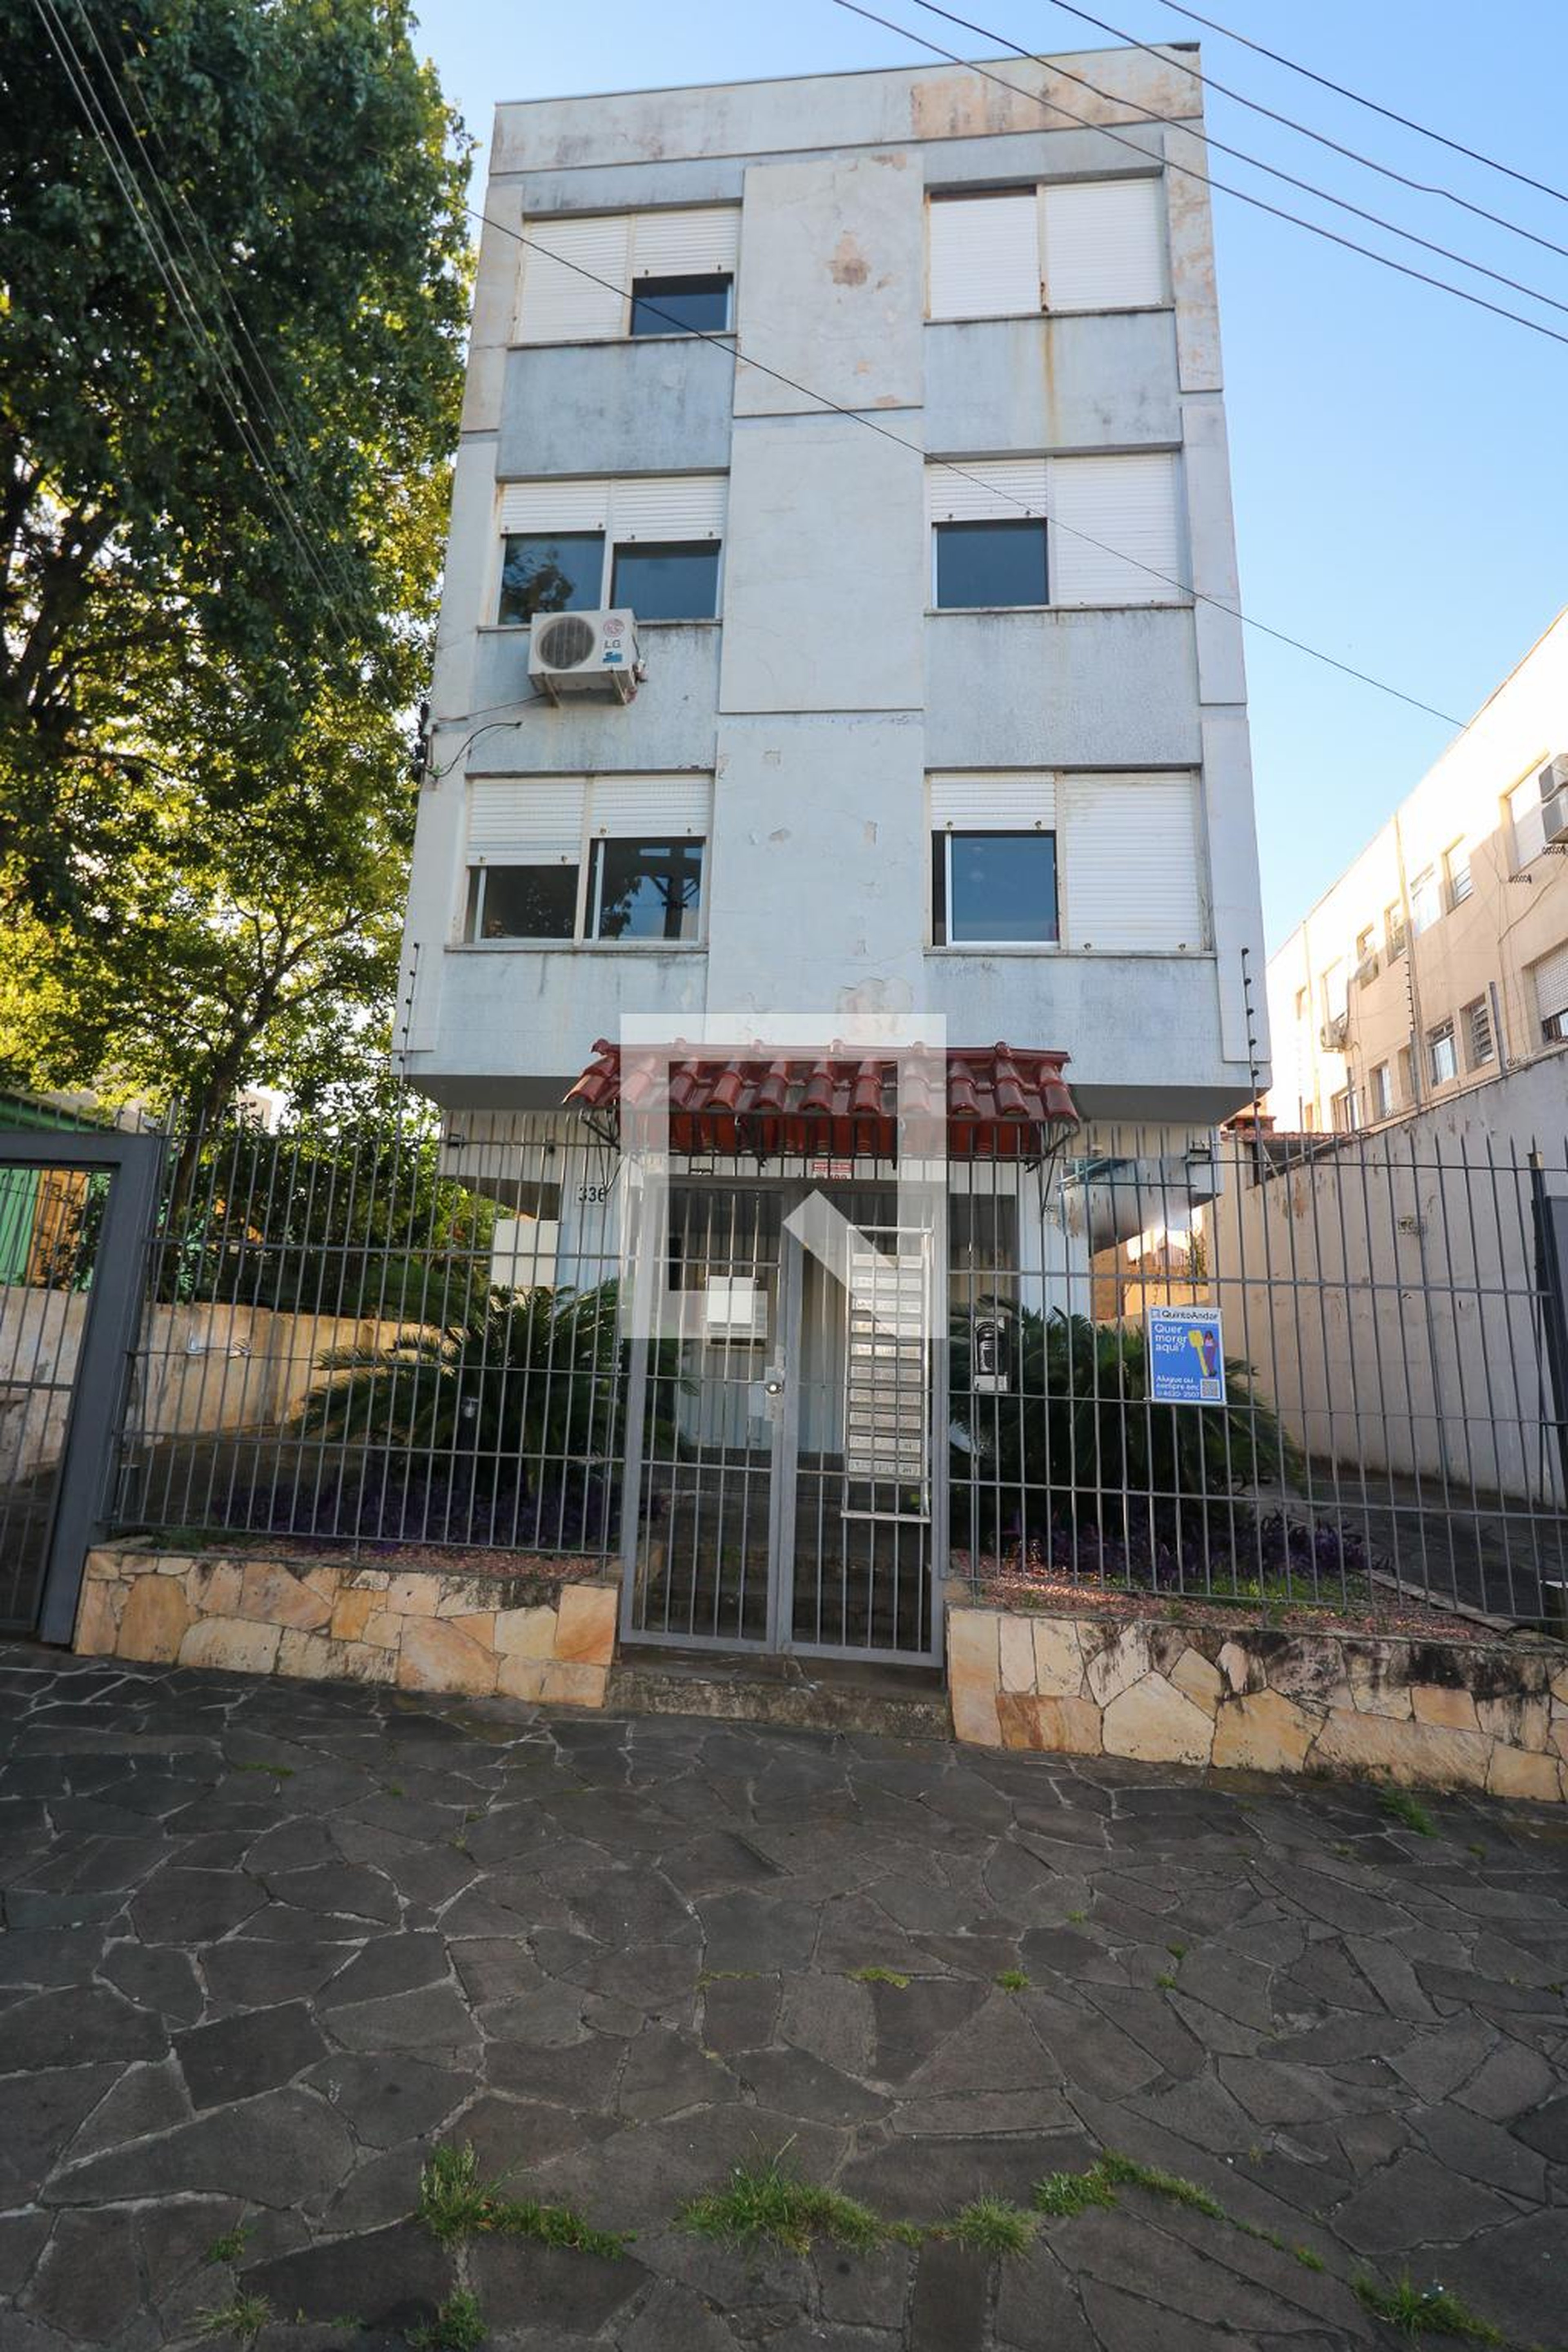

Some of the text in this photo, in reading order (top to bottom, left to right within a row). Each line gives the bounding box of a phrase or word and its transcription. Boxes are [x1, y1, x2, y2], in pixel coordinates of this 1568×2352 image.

[604, 639, 621, 648] LG
[1162, 1310, 1218, 1320] QuintoAndar
[1155, 1323, 1183, 1333] Quer
[1155, 1343, 1185, 1353] aqui?
